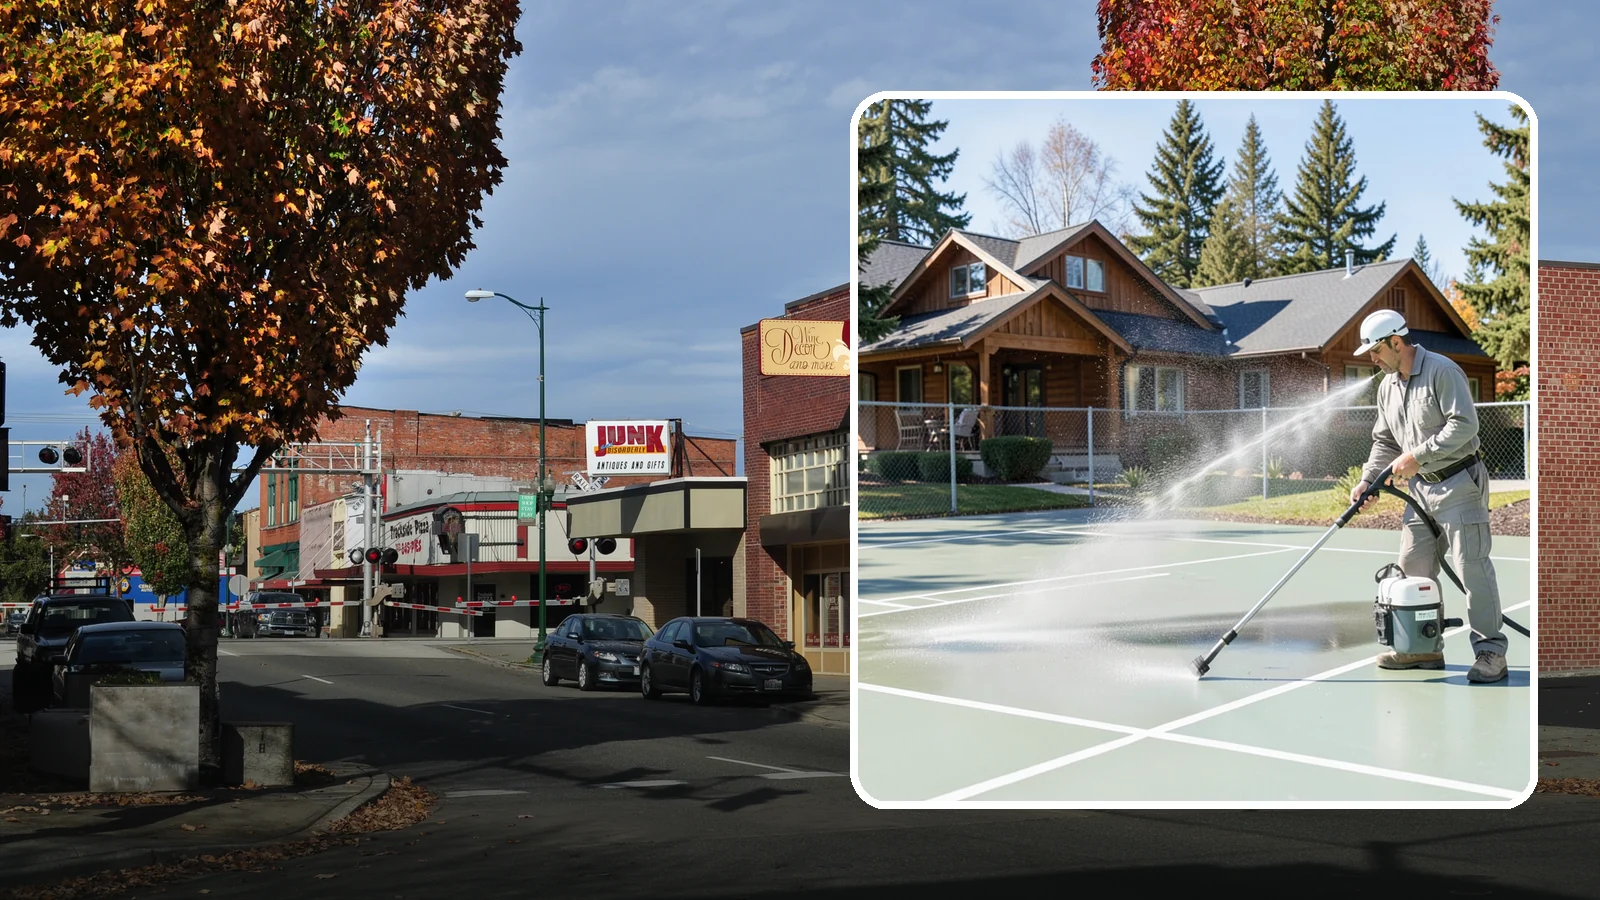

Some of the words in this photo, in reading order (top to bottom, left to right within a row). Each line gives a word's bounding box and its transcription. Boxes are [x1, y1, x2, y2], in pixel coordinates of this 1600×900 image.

[595, 425, 665, 457] JUNK
[607, 446, 645, 454] DISORDERLY
[597, 461, 628, 470] ANTIQUES
[631, 461, 644, 470] AND
[647, 460, 665, 469] GIFTS
[390, 521, 413, 539] Trackside
[415, 519, 429, 535] Pizza
